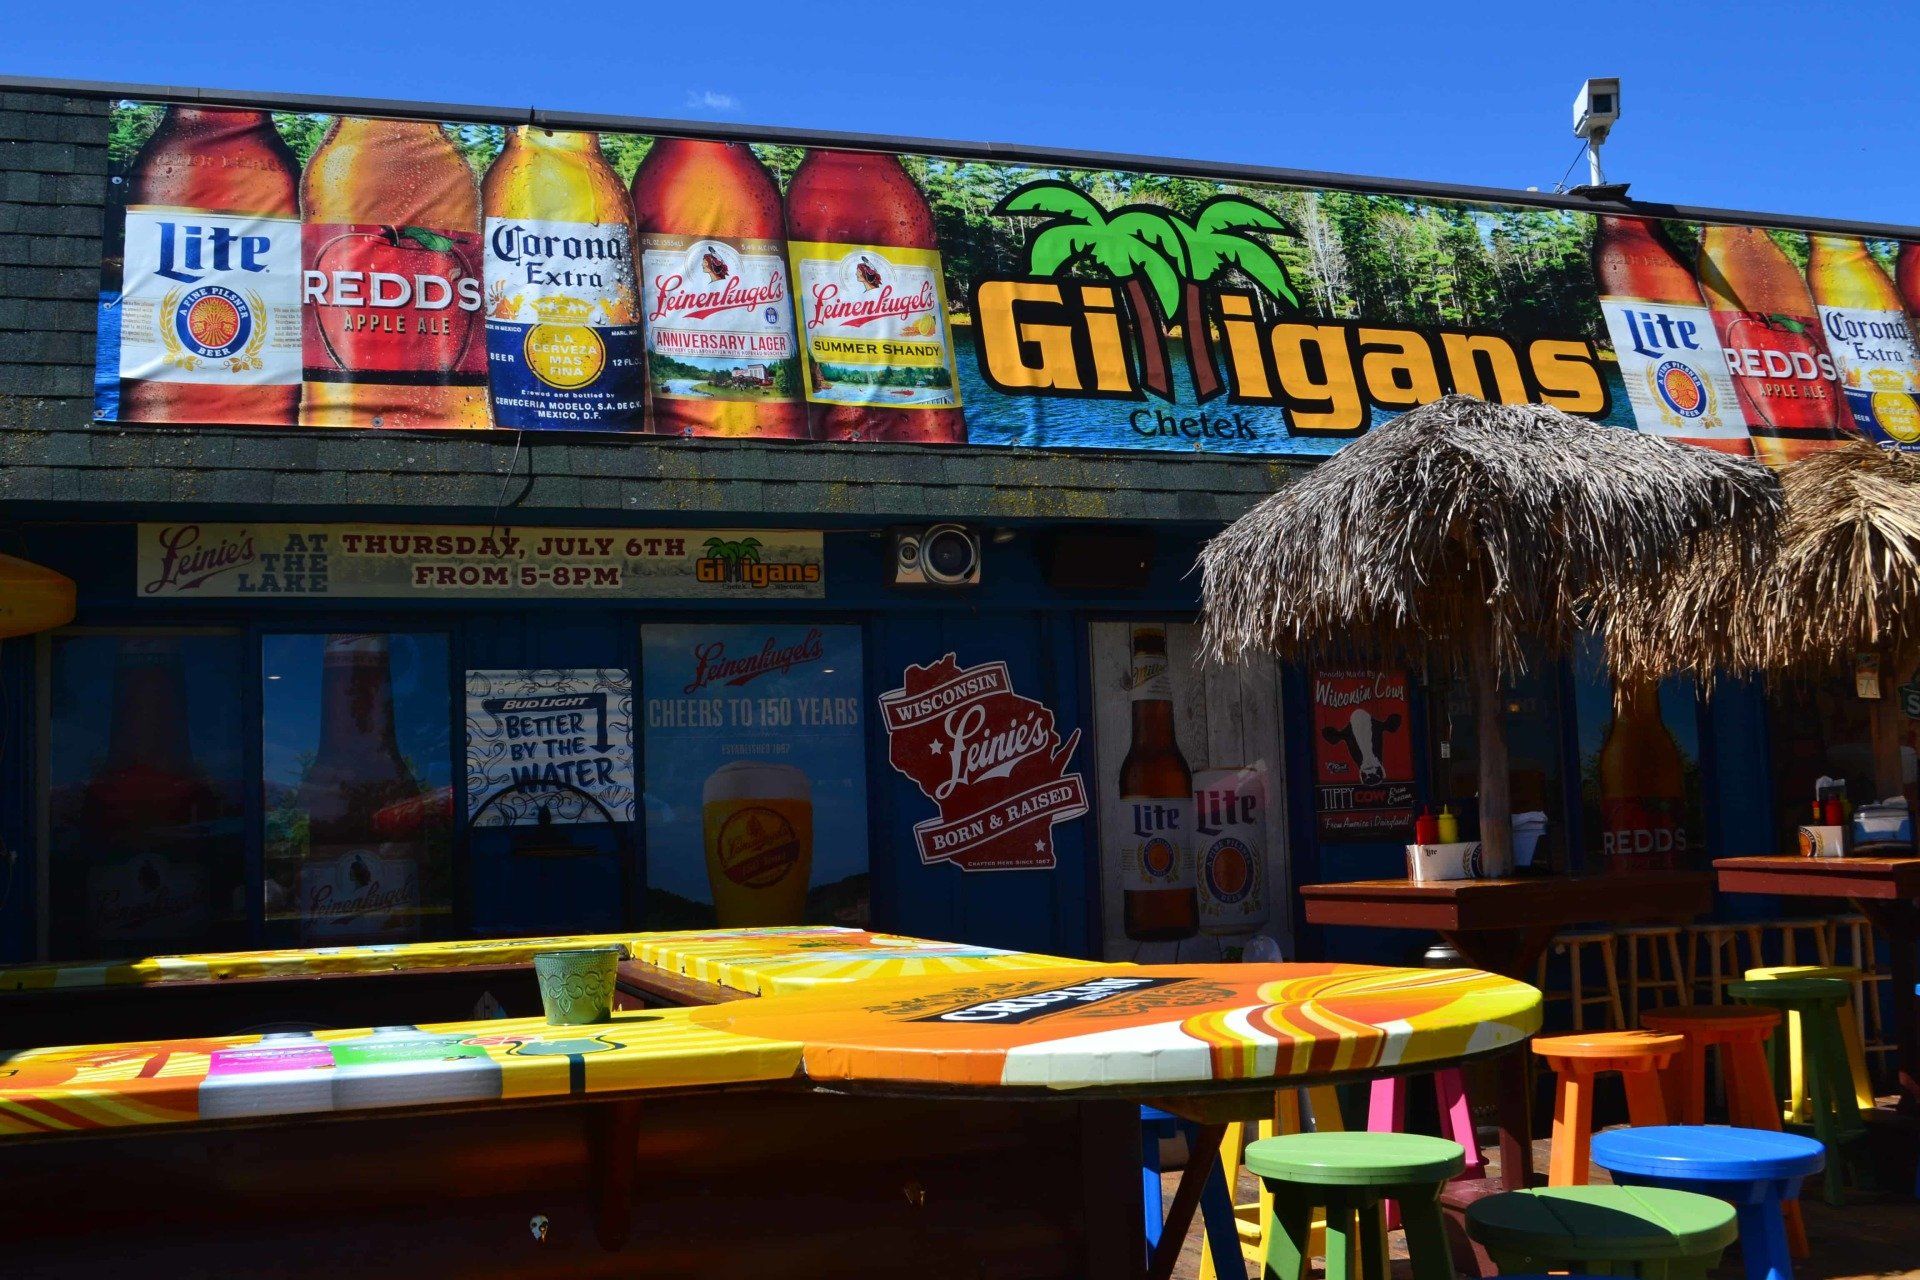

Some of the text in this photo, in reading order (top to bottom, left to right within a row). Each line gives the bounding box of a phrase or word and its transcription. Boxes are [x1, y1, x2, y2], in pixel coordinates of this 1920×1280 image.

[153, 221, 270, 283] Lite
[492, 224, 623, 266] Corona
[525, 261, 603, 287] Extra
[183, 288, 207, 307] FINE
[211, 287, 249, 319] PILSNER
[649, 271, 783, 322] Leinenkugel's
[808, 280, 934, 329] Leinenkugel's
[344, 311, 450, 335] APPLE ALE
[1621, 309, 1700, 359] Lite
[1826, 311, 1909, 345] Corona
[555, 334, 573, 343] LA
[657, 331, 786, 351] ANNIVERSARY LAGER
[814, 340, 939, 356] SUMMER SHANDY
[197, 347, 231, 357] BEER
[490, 352, 514, 362] BEER
[533, 344, 597, 355] CERVEZA
[612, 359, 623, 367] 12
[550, 356, 582, 366] MAS
[1853, 342, 1903, 362] Extra
[550, 366, 584, 376] FINA
[1672, 361, 1701, 387] PILSNER
[495, 396, 545, 409] CERVECERIA
[549, 402, 594, 411] MODELO,
[521, 389, 550, 397] Brewed
[1760, 383, 1826, 398] APPLE ALE
[537, 410, 602, 420] MEXICO, D.F.
[1130, 409, 1257, 440] Chetek
[145, 525, 255, 593] Leinie's
[284, 534, 686, 560] AT THURSDAY, JULY 6TH
[260, 553, 328, 572] THE
[237, 573, 328, 592] LAKE
[415, 566, 620, 586] FROM 5-8PM
[684, 627, 823, 694] Leinenkugel's
[896, 673, 998, 722] WISCONSIN
[1315, 671, 1407, 708] Wisconsin Cows
[650, 697, 859, 728] CHEERS TO 150 YEARS
[505, 713, 585, 739] BETTER
[510, 737, 586, 761] BY THE
[935, 705, 1049, 800] Leinie's
[510, 757, 617, 795] WATER
[1320, 787, 1354, 810] TIPPY
[932, 786, 1073, 851] BORN & RAISED
[1132, 804, 1180, 837] Lite
[1194, 790, 1257, 836] Lite
